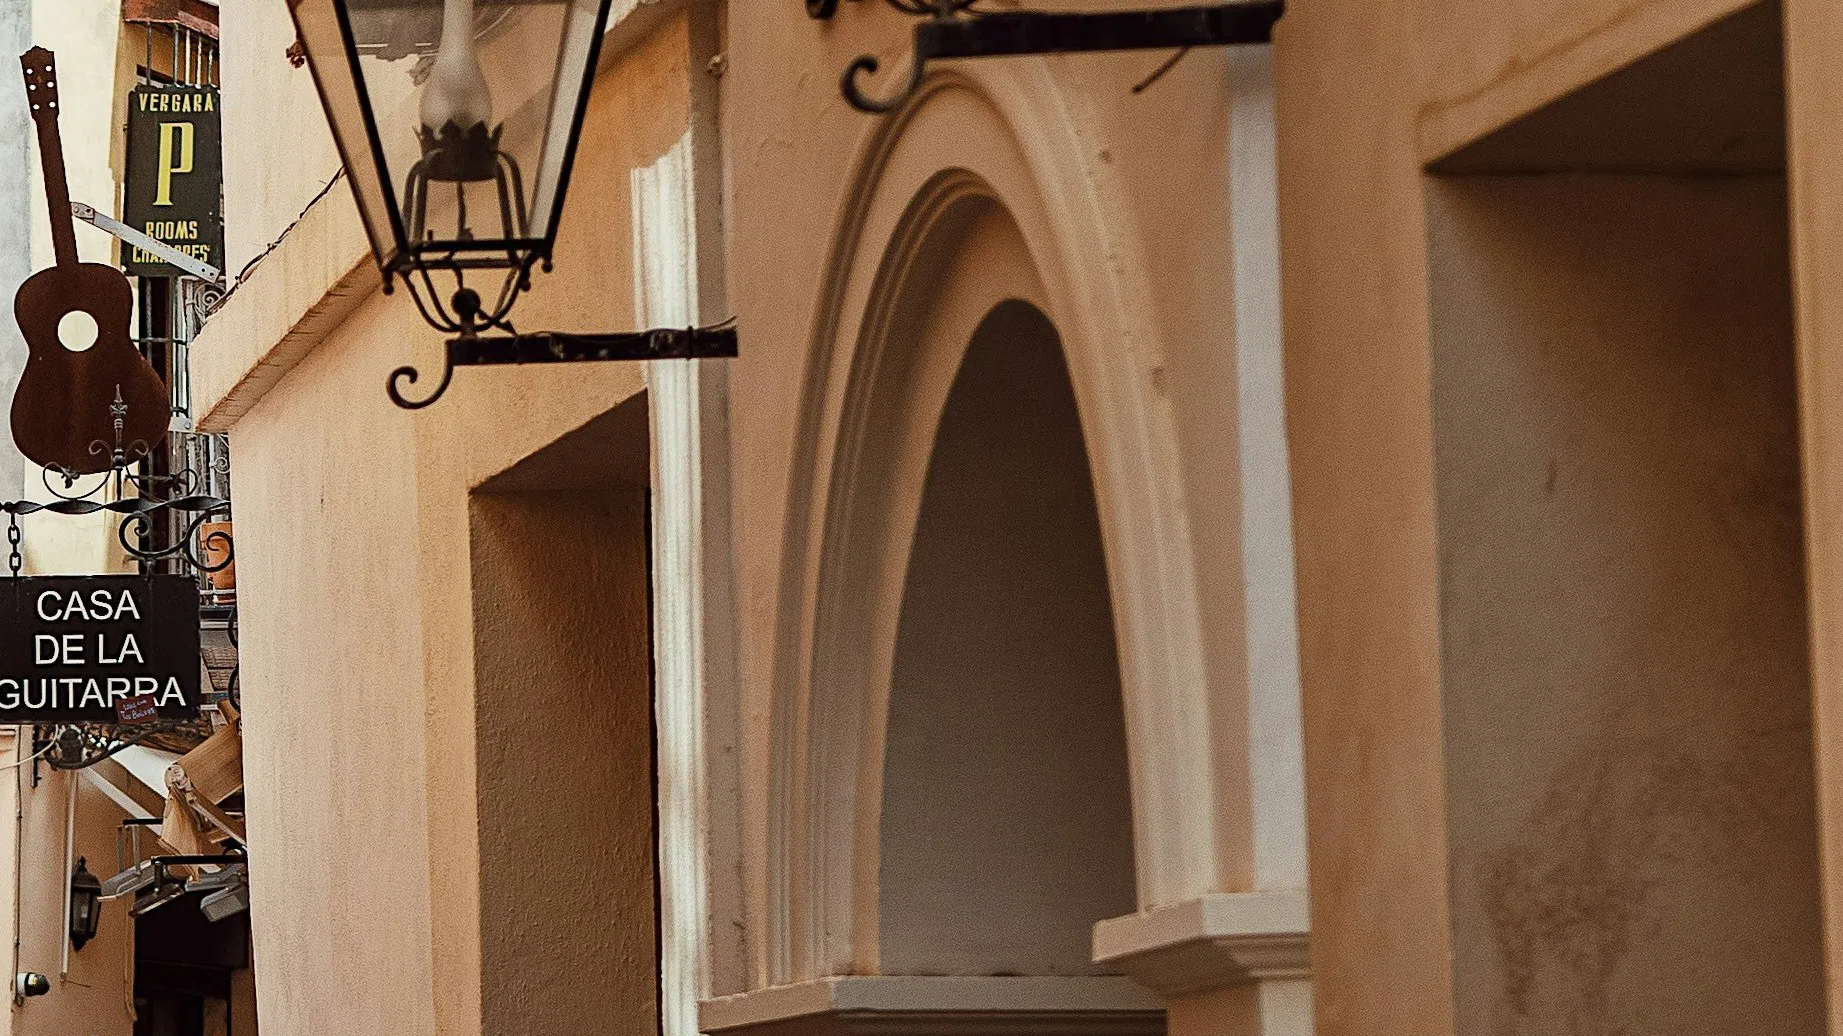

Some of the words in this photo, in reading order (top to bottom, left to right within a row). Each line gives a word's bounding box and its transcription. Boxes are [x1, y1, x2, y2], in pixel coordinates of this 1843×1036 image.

[138, 93, 214, 113] VERGARA
[152, 122, 194, 206] P
[145, 221, 198, 240] ROOMS
[37, 589, 141, 621] CASA
[34, 633, 86, 665] DE
[98, 633, 145, 664] LA
